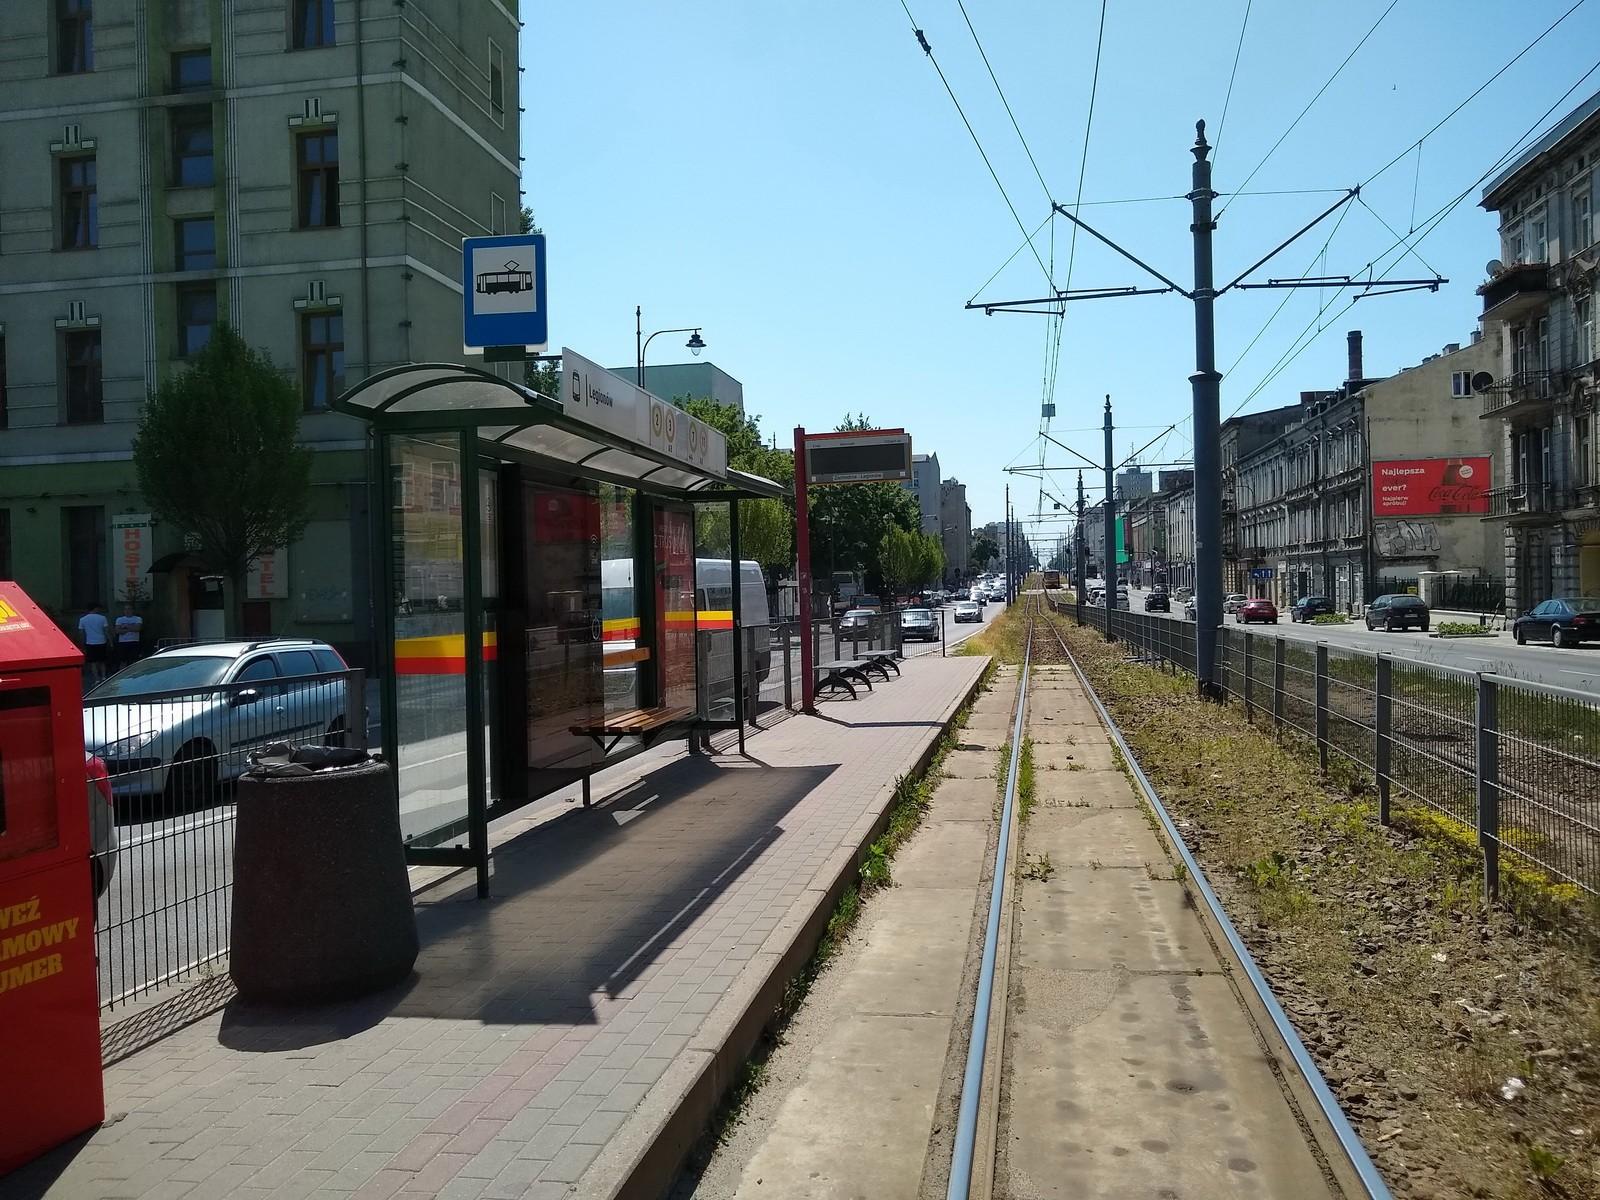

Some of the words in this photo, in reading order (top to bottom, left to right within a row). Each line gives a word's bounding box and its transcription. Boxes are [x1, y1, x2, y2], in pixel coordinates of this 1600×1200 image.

[588, 383, 613, 408] Legionów
[1381, 468, 1425, 476] Najlepsza
[1382, 484, 1407, 492] ever?
[124, 528, 142, 597] HOSTE
[0, 917, 79, 960] MOWY
